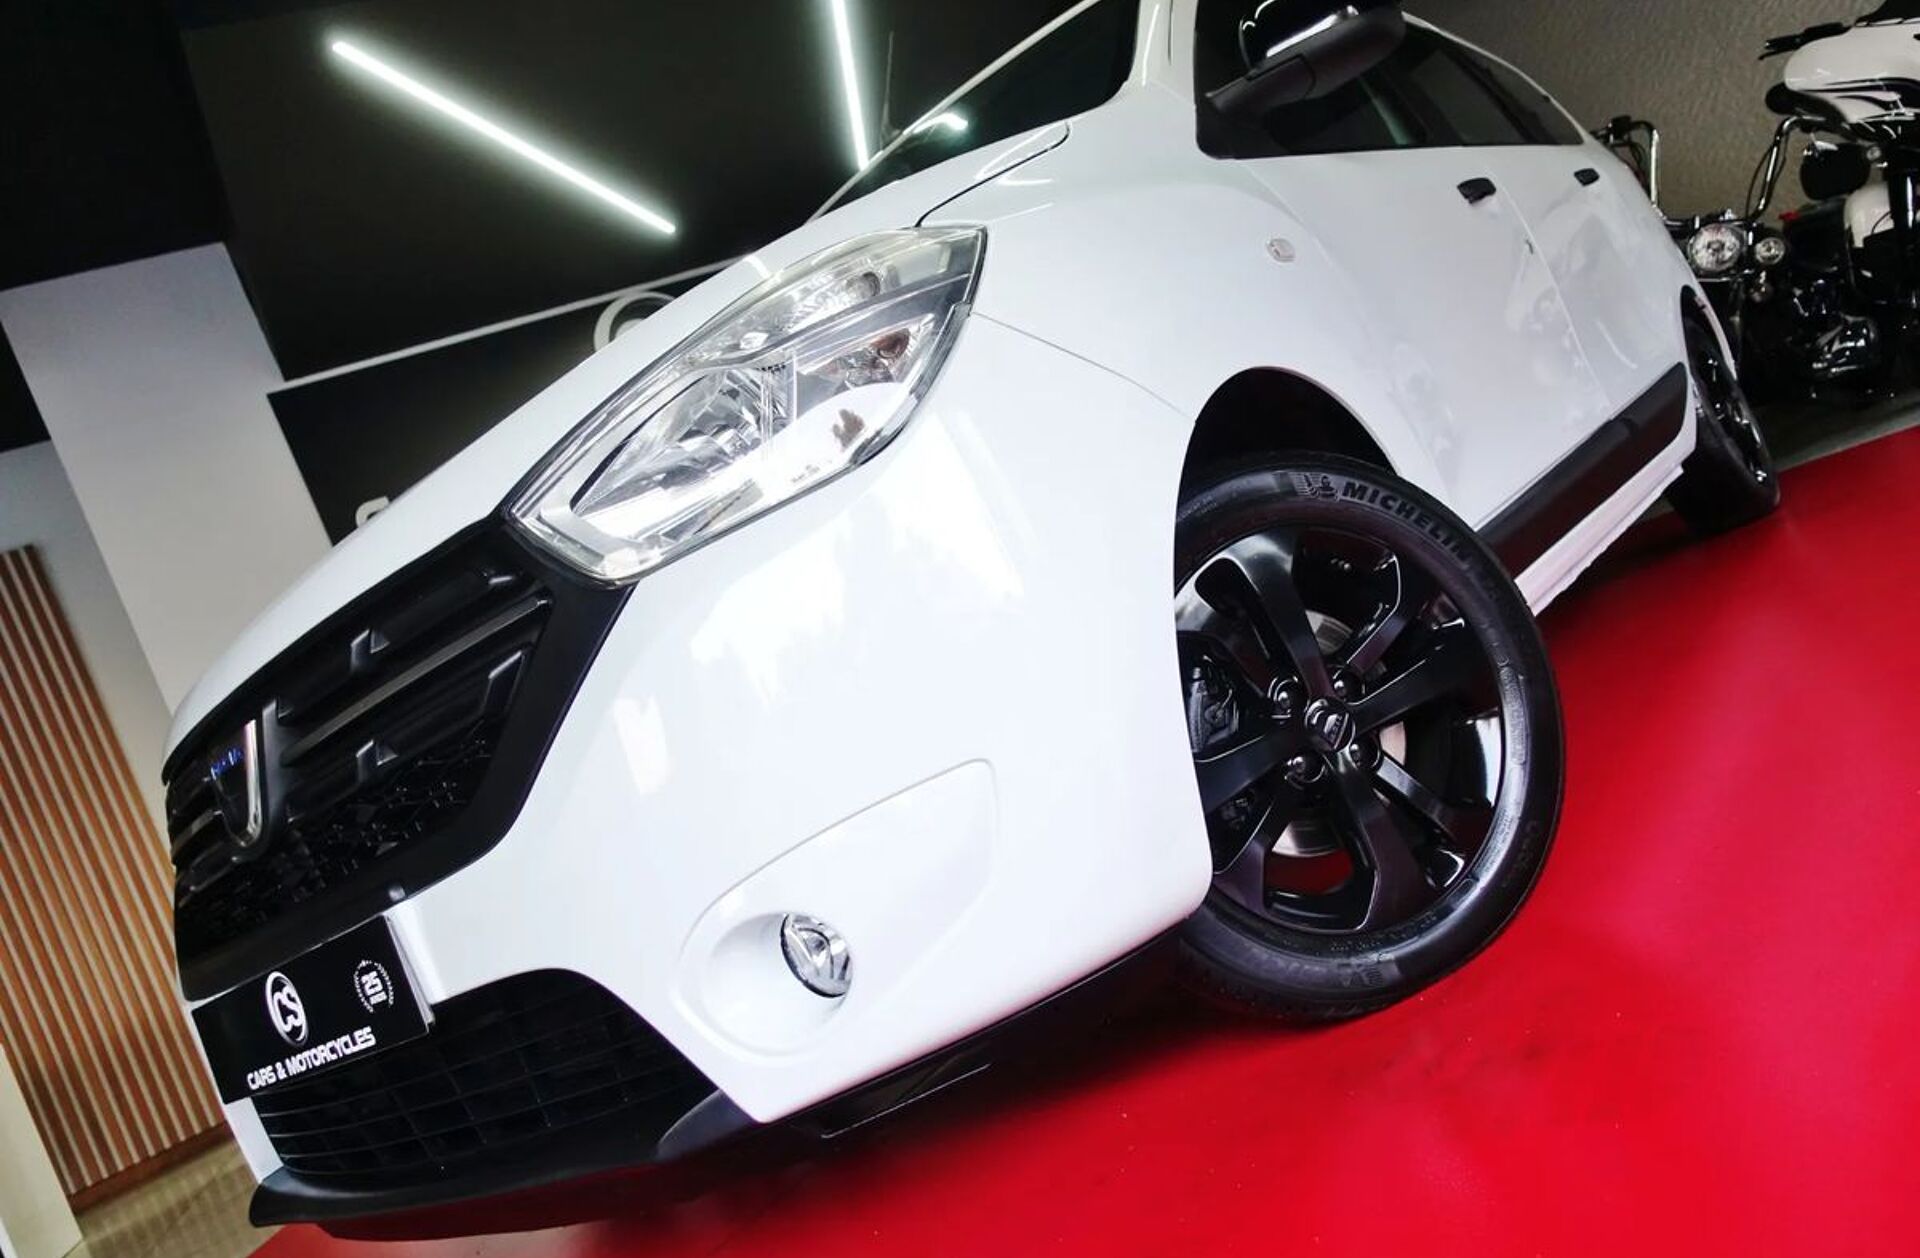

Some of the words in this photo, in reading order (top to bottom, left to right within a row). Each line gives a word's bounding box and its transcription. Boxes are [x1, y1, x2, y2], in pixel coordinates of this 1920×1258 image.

[1341, 480, 1472, 565] MICHELIN
[247, 1066, 277, 1090] CARS
[276, 1061, 288, 1079] &
[285, 1026, 376, 1076] MOTORCYCLES
